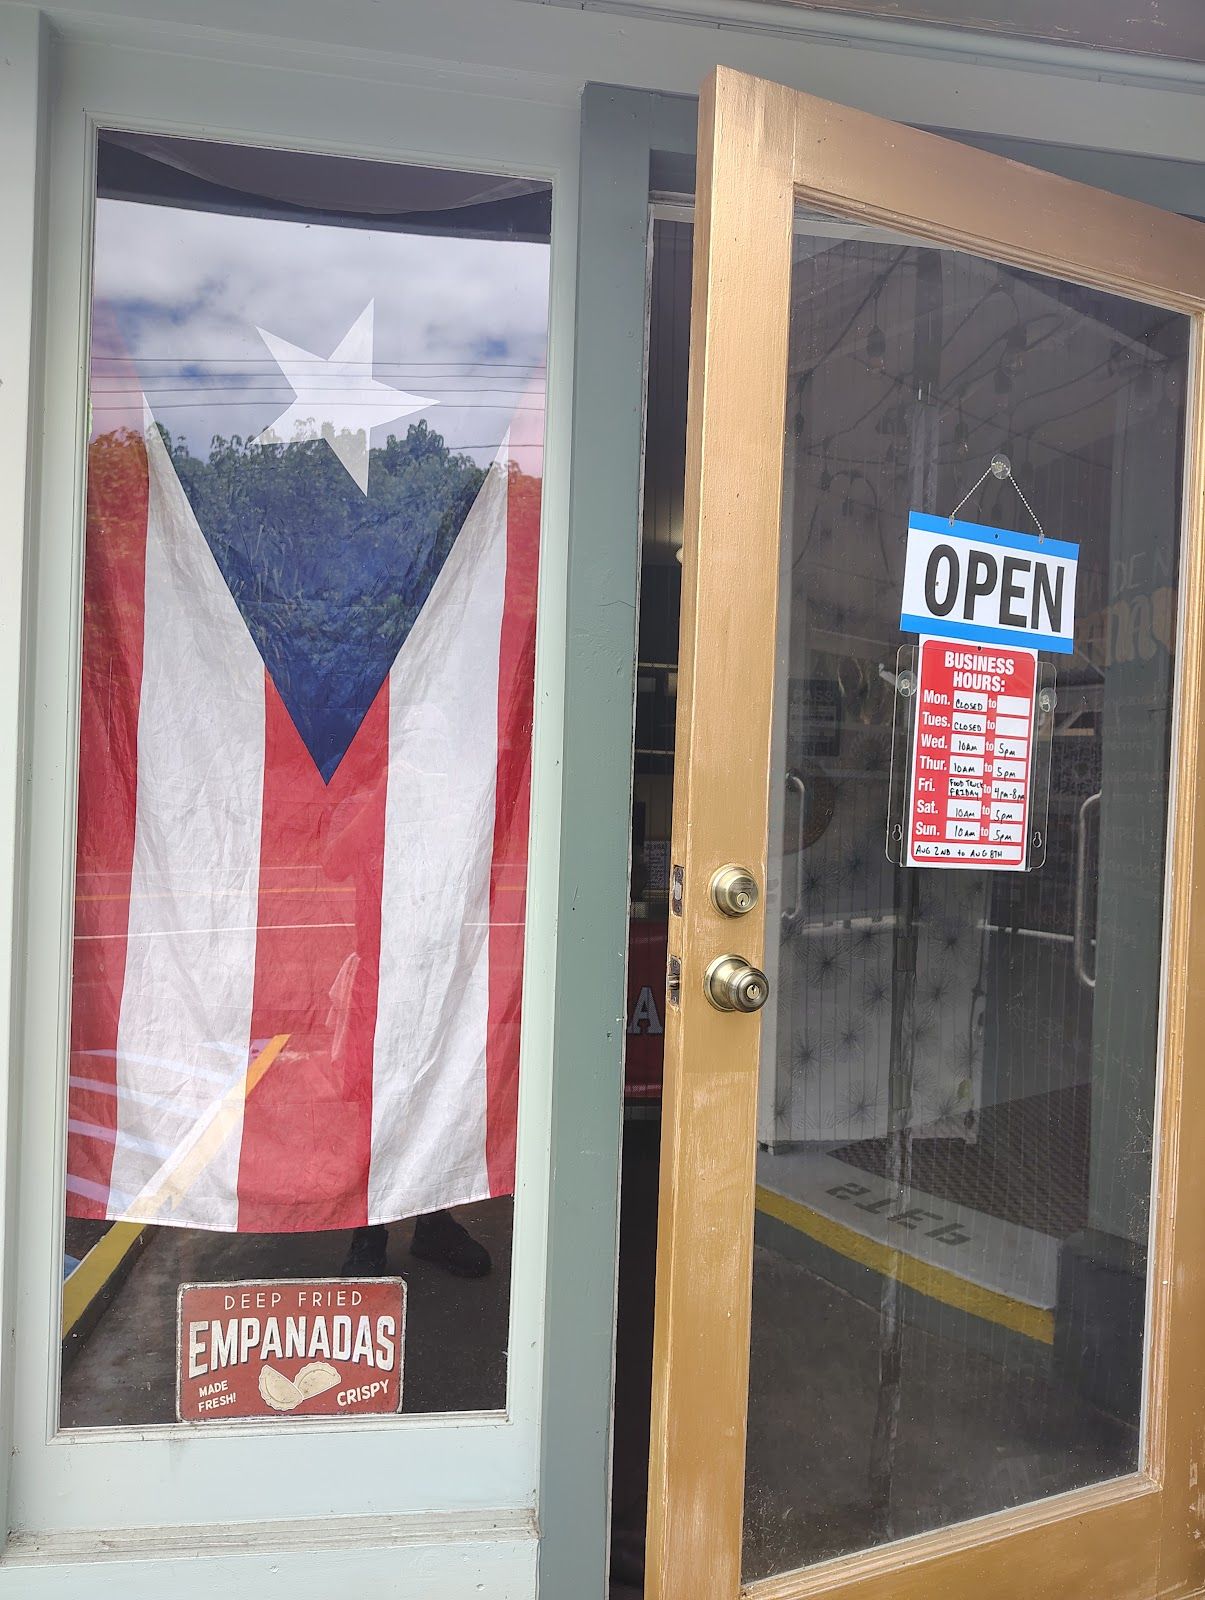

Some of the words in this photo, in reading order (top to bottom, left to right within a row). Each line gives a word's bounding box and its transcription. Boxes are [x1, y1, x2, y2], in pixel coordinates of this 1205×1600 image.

[925, 544, 1065, 633] OPEN
[944, 651, 1015, 675] BUSINESS
[953, 671, 1005, 692] HOURS:
[923, 689, 950, 705] Mon.
[955, 698, 983, 711] CLOSED
[988, 698, 996, 709] to
[922, 711, 951, 728] Tues.
[954, 721, 982, 732] CLOSED
[987, 720, 995, 730] to
[921, 734, 948, 749] Wed.
[985, 741, 994, 751] to
[919, 755, 947, 770] Thur.
[984, 762, 992, 773] to
[918, 778, 935, 792] Fri.
[983, 784, 991, 794] to
[917, 799, 938, 814] Sat.
[982, 805, 990, 815] to
[915, 821, 940, 836] Sun.
[981, 826, 989, 837] to
[934, 846, 951, 856] 2ND
[958, 847, 965, 857] to
[224, 1292, 282, 1310] DEEP
[298, 1290, 362, 1307] FRIED
[188, 1315, 396, 1379] EMPANADAS
[198, 1379, 228, 1398] MADE
[336, 1379, 390, 1407] CRISPY
[197, 1393, 236, 1413] FRESH!
